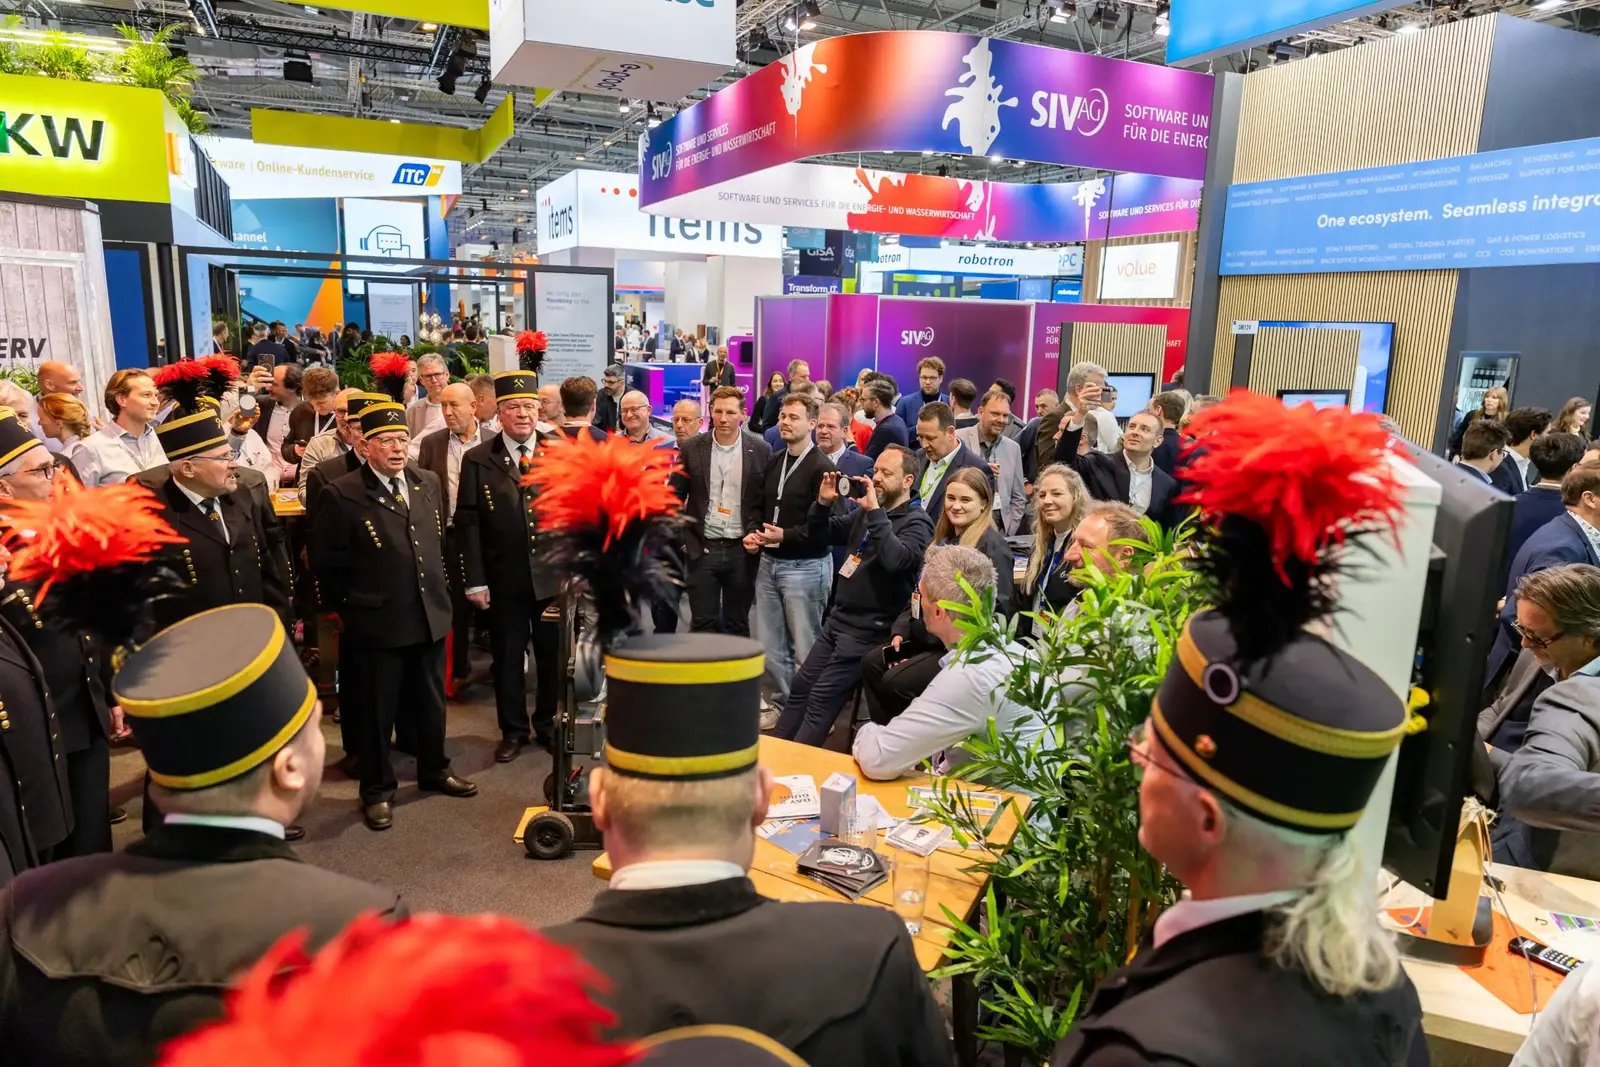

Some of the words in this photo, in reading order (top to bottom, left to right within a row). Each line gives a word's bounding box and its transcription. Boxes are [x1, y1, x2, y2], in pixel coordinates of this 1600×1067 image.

[1124, 103, 1188, 126] SOFTWARE
[0, 111, 104, 161] KW
[676, 137, 696, 155] SOFTWARE
[697, 133, 706, 147] UND
[707, 122, 729, 142] SERVICES
[1123, 122, 1147, 140] FÜR
[1150, 128, 1170, 144] DIE
[676, 157, 684, 171] FÜR
[691, 148, 711, 165] ENERGIE-
[712, 143, 722, 157] UND
[723, 121, 777, 153] WASSERWIRTSCHAFT
[256, 160, 375, 181] Online-Kundenservice
[1412, 165, 1461, 177] NOMINATIONS
[1470, 158, 1513, 170] BALANCING
[1522, 150, 1576, 164] SCHEDULING
[399, 168, 425, 184] ITC
[1467, 173, 1509, 184] HYDROGEN
[1519, 167, 1556, 178] SUPPORT
[1557, 165, 1575, 174] FOR
[718, 191, 761, 204] SOFTWARE
[763, 196, 781, 206] UND
[783, 197, 819, 208] SERVICES
[821, 199, 836, 209] FÜR
[838, 201, 850, 210] DIE
[852, 202, 887, 213] ENERGIE-
[888, 205, 904, 214] UND
[906, 207, 976, 220] WASSERWIRTSCHAFT
[1129, 205, 1144, 215] UND
[1144, 201, 1174, 213] SERVICES
[1175, 198, 1188, 210] FÜR
[1317, 214, 1345, 228] One
[1349, 208, 1433, 227] ecosystem.
[1442, 198, 1527, 219] Seamless
[548, 206, 573, 240] items
[1388, 242, 1413, 250] VIRTUAL
[1416, 240, 1446, 248] TRADING
[1486, 235, 1502, 244] GAS
[1504, 235, 1510, 243] &
[1512, 232, 1540, 243] POWER
[1542, 230, 1586, 241] LOGISTICS
[958, 253, 1014, 267] robotron
[1517, 245, 1575, 256] NOMINATIONS
[1117, 259, 1157, 277] volue
[788, 283, 828, 293] Transform
[1045, 335, 1059, 345] FÜR
[1167, 339, 1182, 348] HAFT
